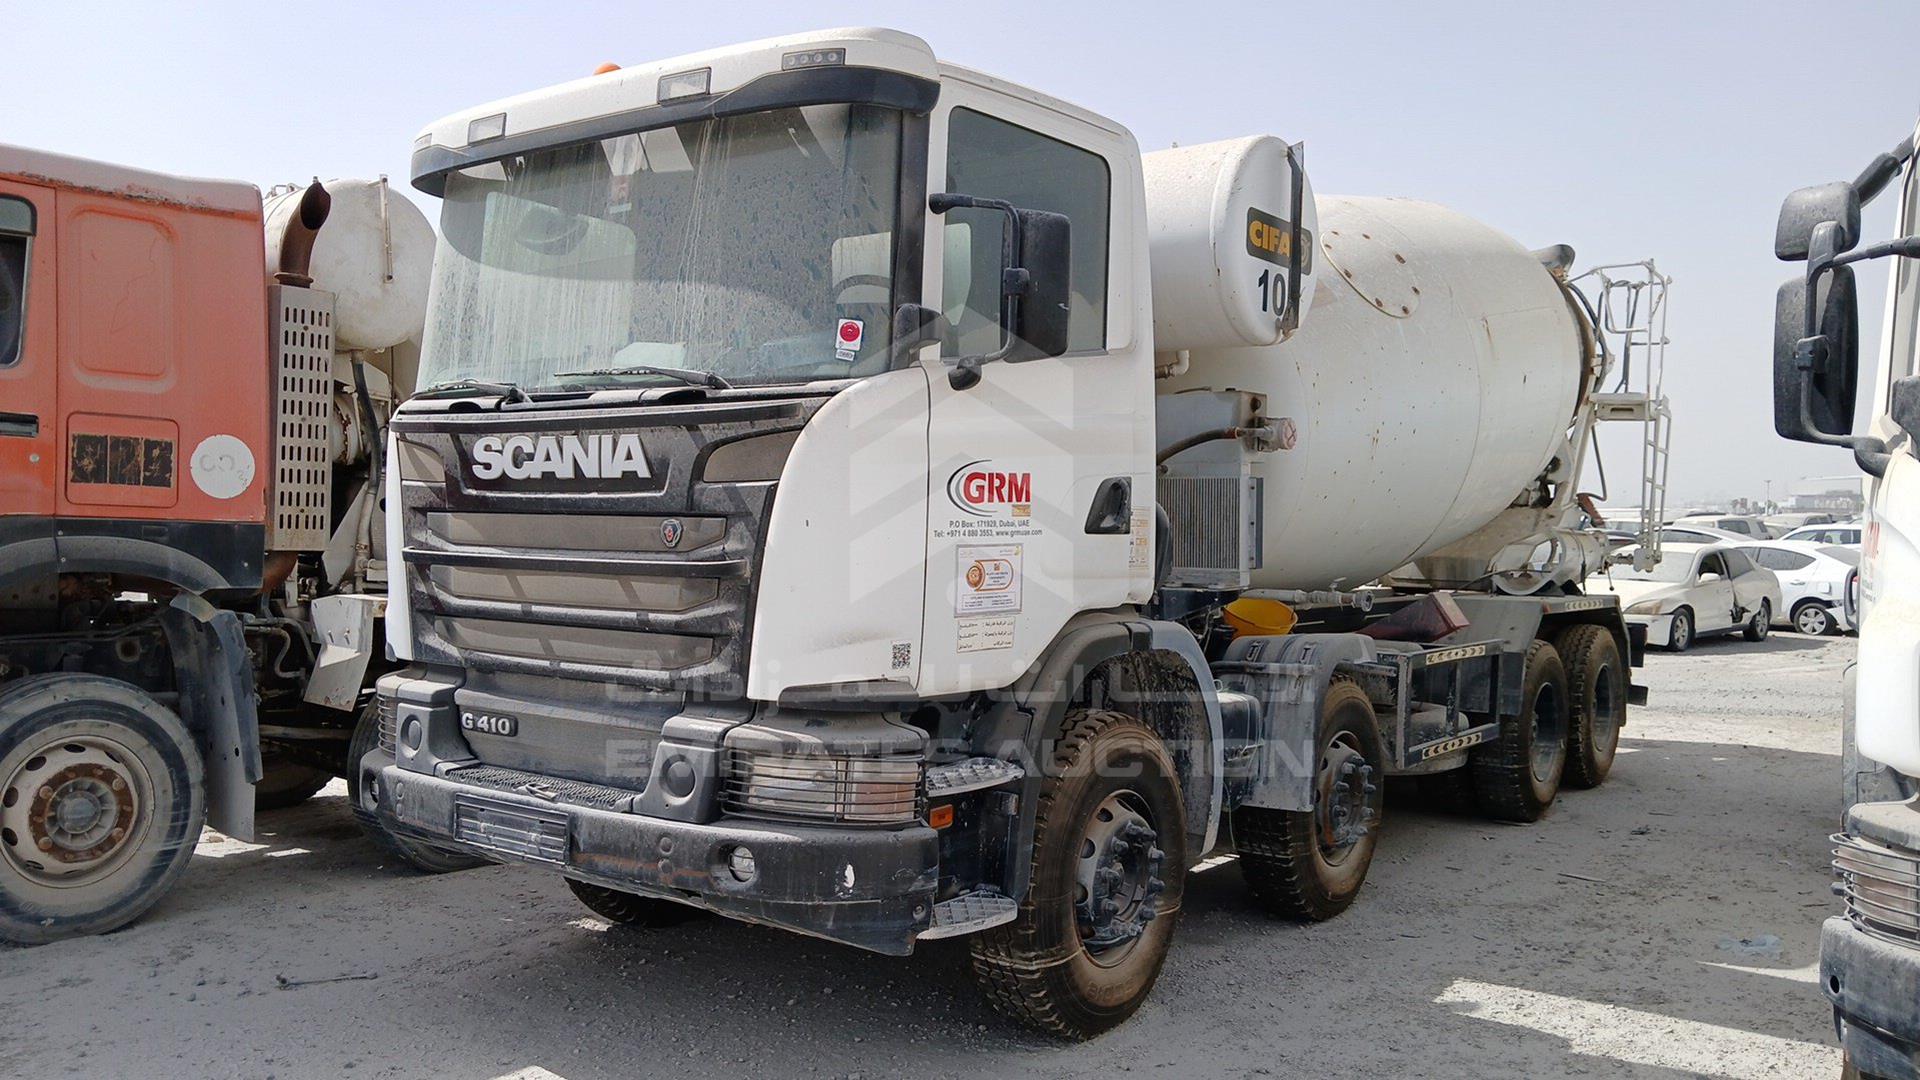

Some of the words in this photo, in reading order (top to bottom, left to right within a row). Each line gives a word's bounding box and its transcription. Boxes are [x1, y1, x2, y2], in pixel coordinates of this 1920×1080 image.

[1249, 220, 1291, 258] CIFA
[1258, 269, 1286, 317] 10
[472, 434, 651, 480] SCANIA
[964, 472, 1031, 503] GRM
[946, 530, 961, 538] +971
[1018, 519, 1030, 527] UAE
[462, 713, 474, 729] G
[477, 716, 510, 735] 410
